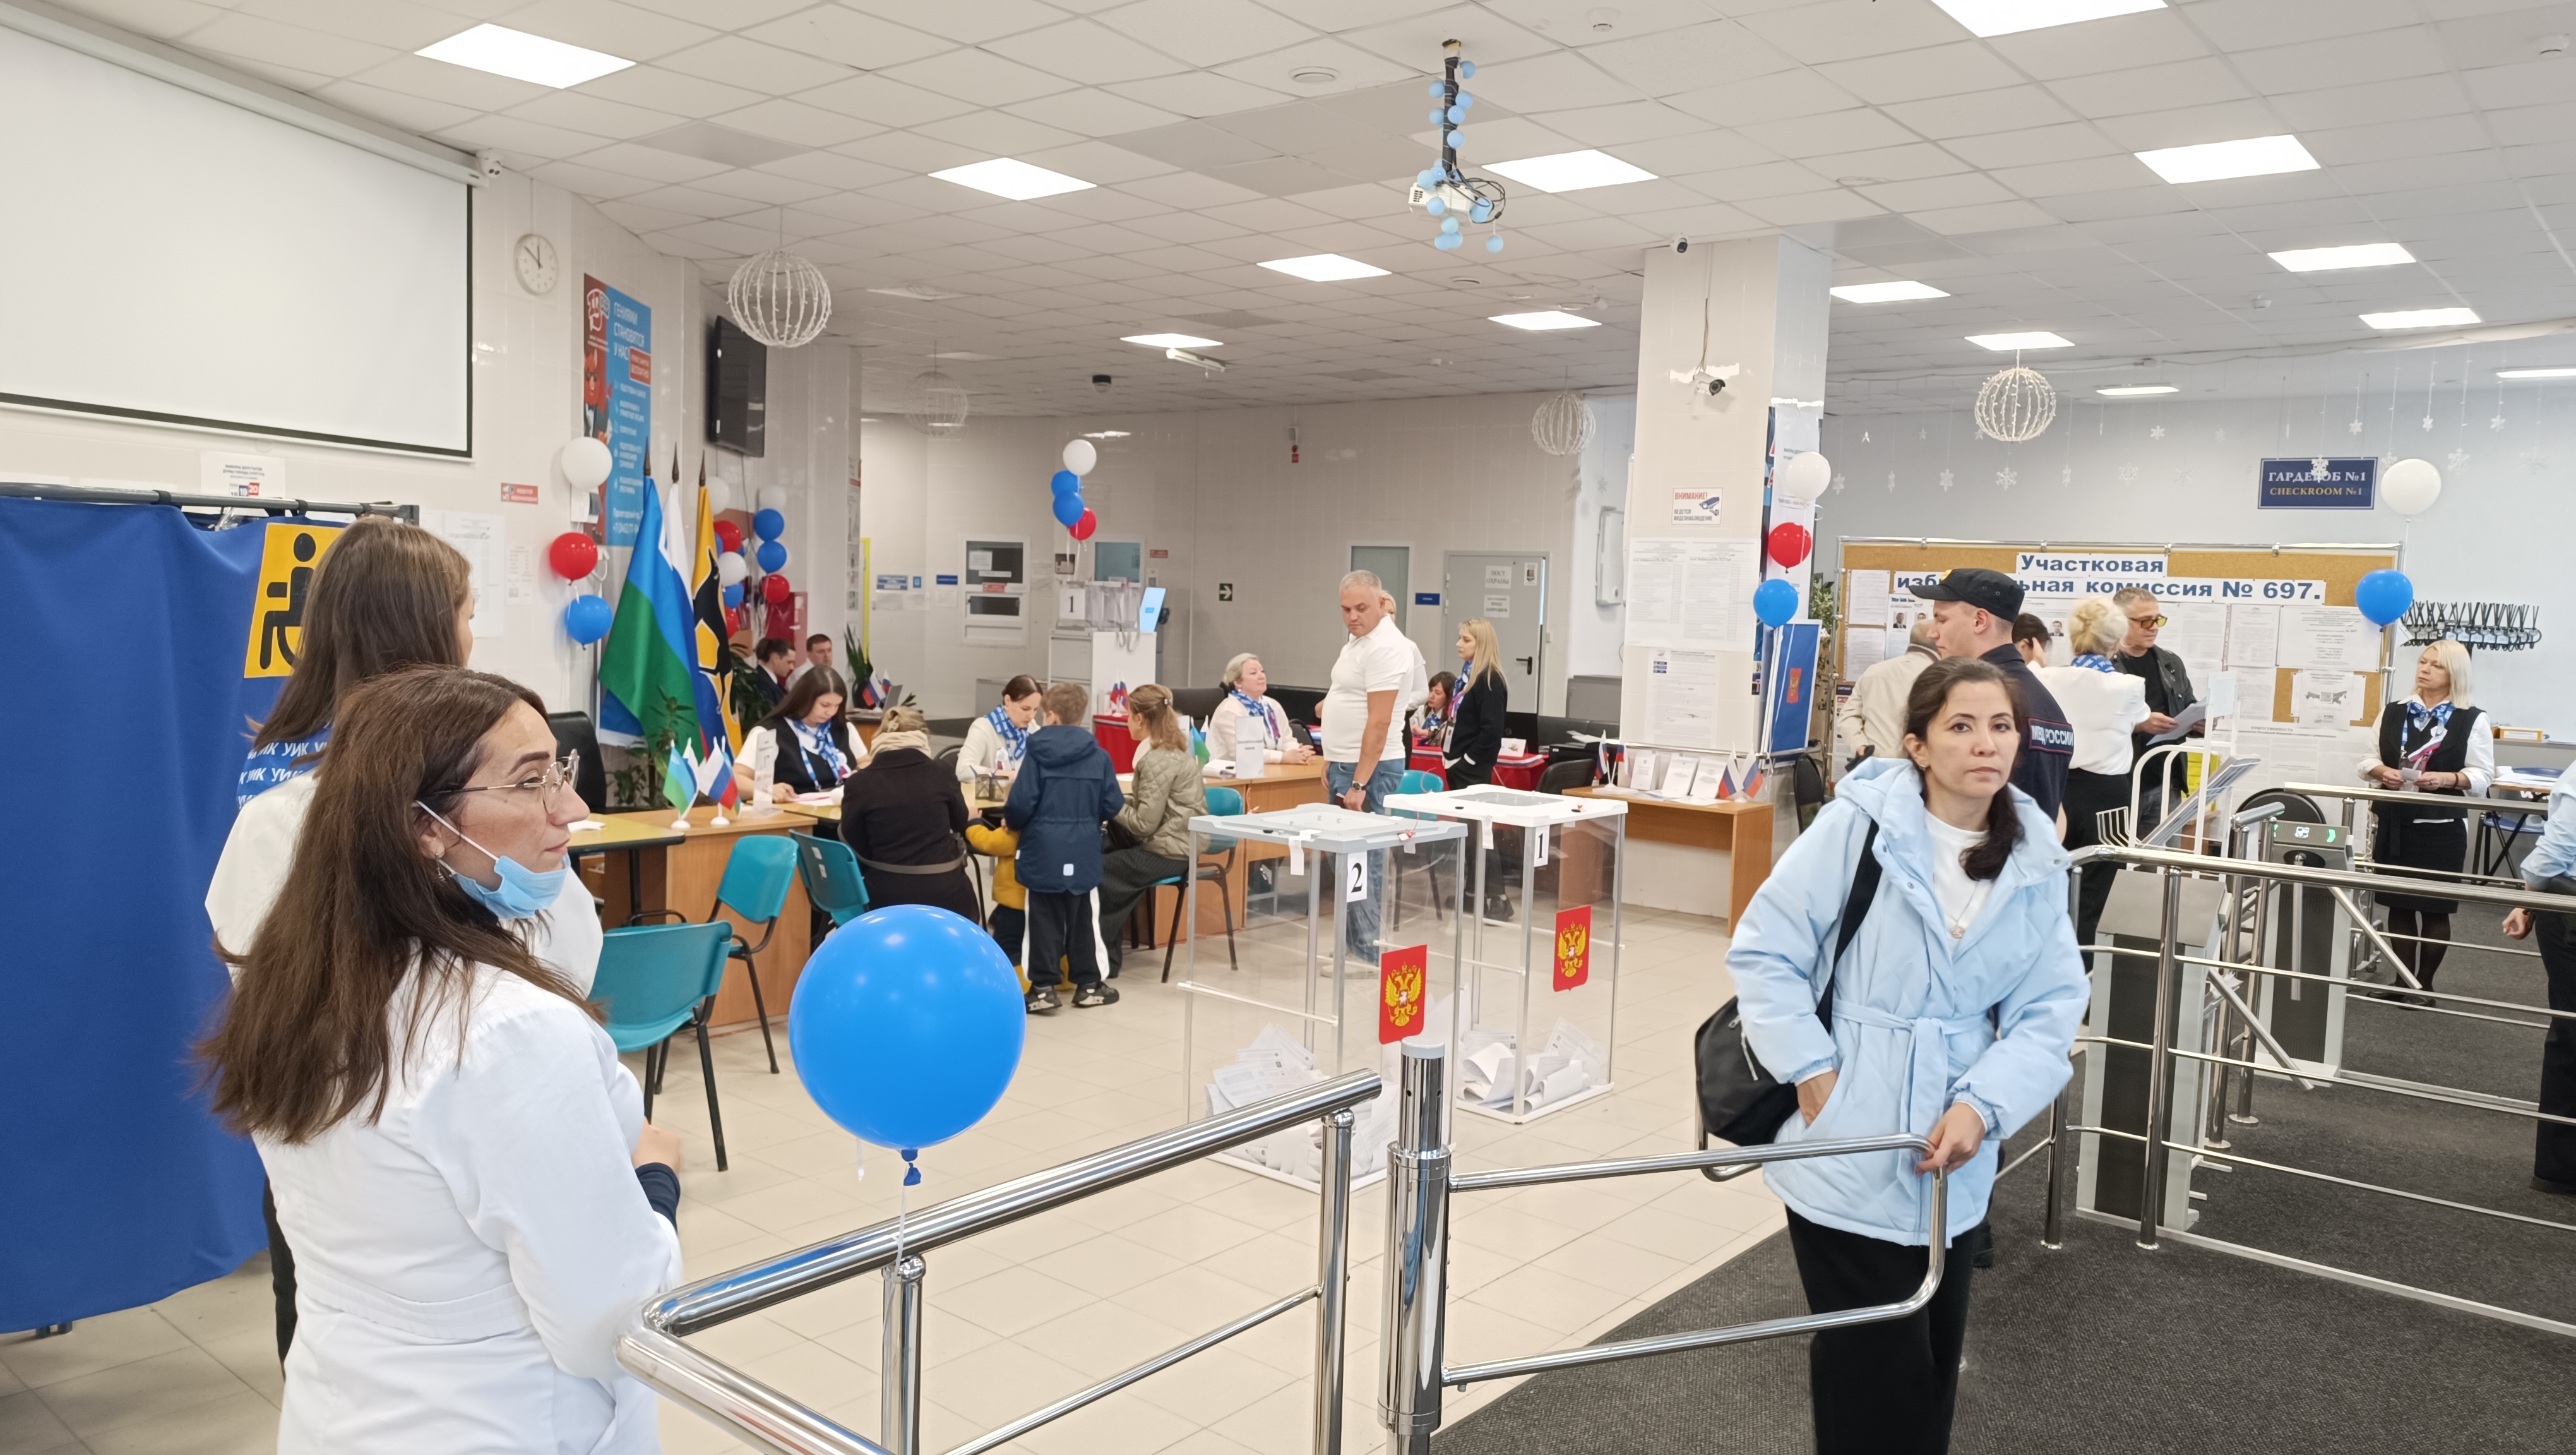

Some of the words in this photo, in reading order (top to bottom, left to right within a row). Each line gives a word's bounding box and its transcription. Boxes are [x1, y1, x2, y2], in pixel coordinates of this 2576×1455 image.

[248, 485, 258, 493] 20
[2270, 488, 2342, 496] CHECKROOM
[2021, 554, 2164, 573] Участковая
[2222, 581, 2253, 597] №
[2263, 582, 2321, 600] 697.
[1068, 595, 1075, 613] 1
[2031, 725, 2046, 745] МВД
[2045, 728, 2073, 746] РОССИИ
[282, 741, 309, 757] УИК
[1536, 832, 1544, 859] 1
[1351, 862, 1363, 894] 2
